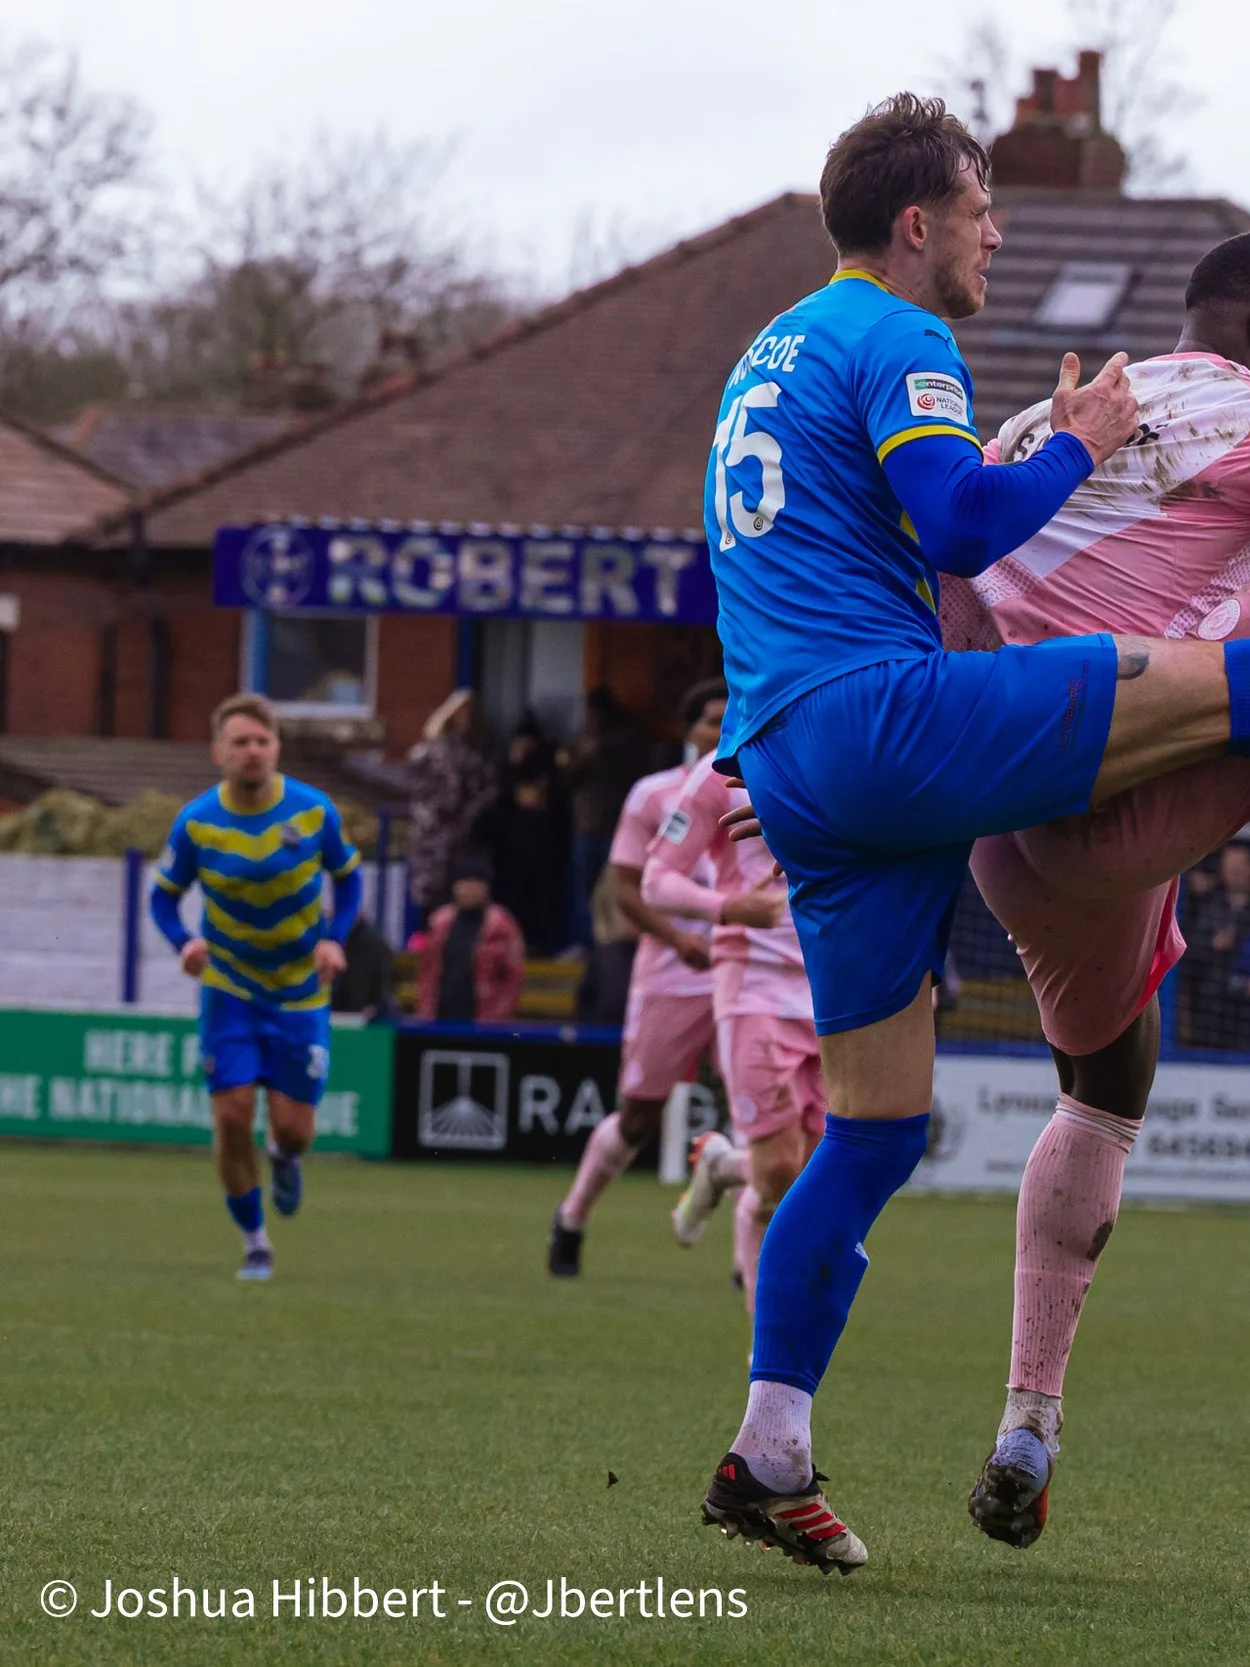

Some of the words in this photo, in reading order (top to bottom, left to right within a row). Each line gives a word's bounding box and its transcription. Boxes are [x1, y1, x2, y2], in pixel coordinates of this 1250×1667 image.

[713, 381, 786, 552] 15
[327, 536, 697, 615] ROBERT
[84, 1029, 173, 1077] HERE
